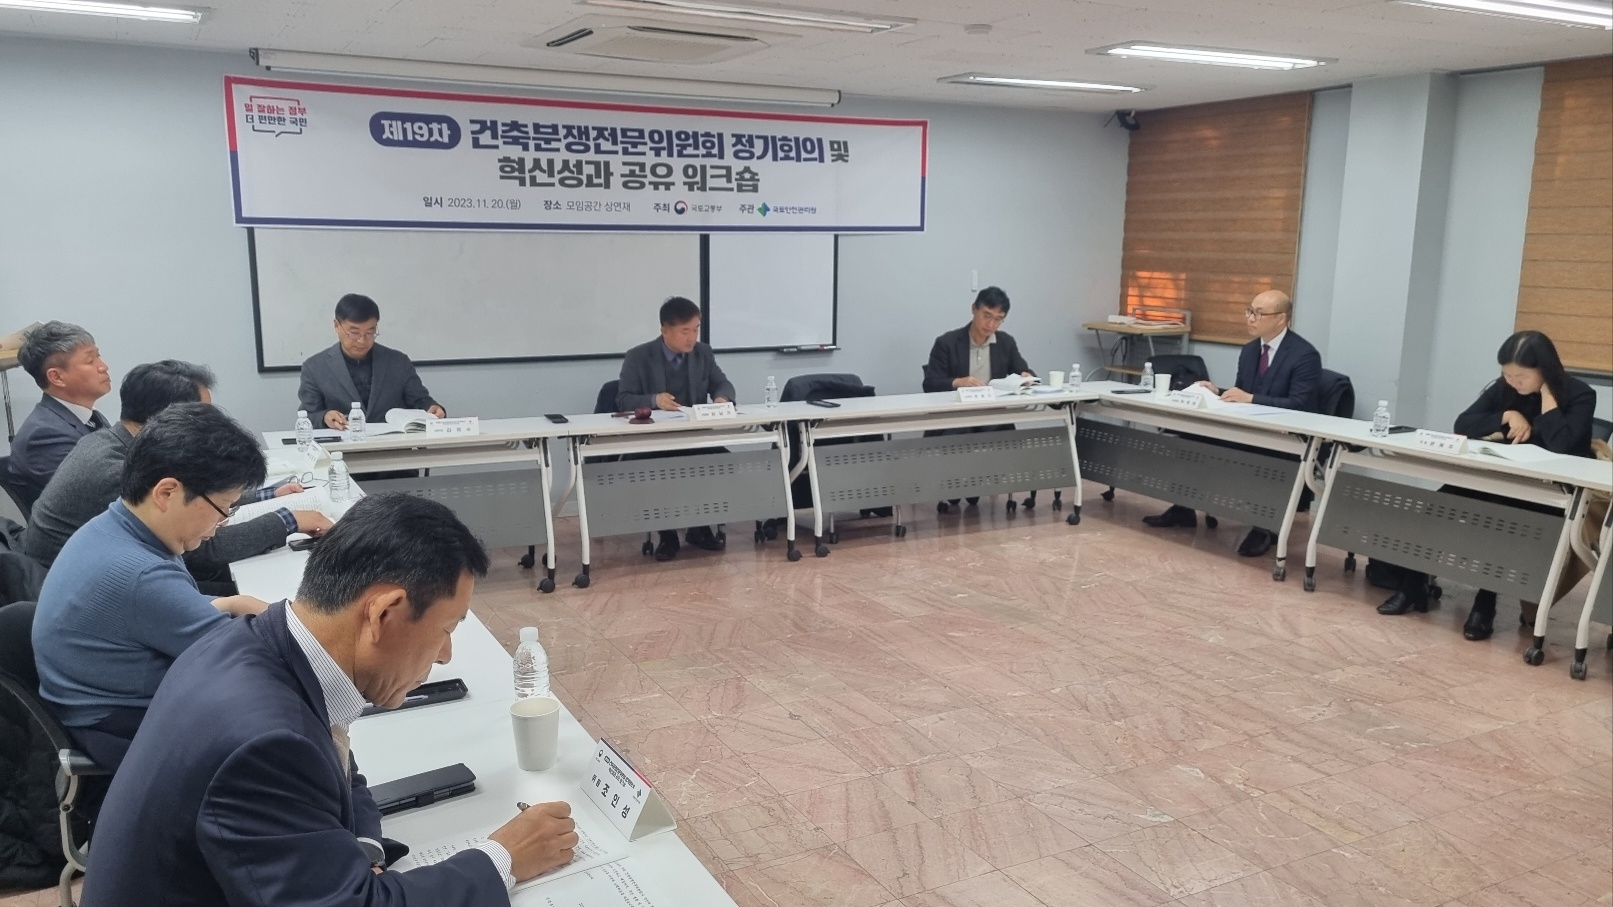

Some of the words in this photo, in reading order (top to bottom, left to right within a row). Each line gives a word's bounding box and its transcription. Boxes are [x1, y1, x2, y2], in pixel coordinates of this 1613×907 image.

[257, 103, 285, 115] 잘하는
[288, 105, 307, 116] 정부
[245, 114, 255, 124] 더
[289, 116, 308, 127] 국민
[380, 119, 451, 143] 제19차
[469, 118, 726, 161] 건축분쟁전문위원회
[731, 132, 825, 164] 정기회의
[829, 139, 850, 164] 및
[497, 156, 614, 190] 혁신성과
[620, 160, 676, 191] 공유
[682, 162, 760, 193] 워크숍
[422, 196, 443, 208] 일시
[543, 200, 562, 211] 장소
[565, 200, 602, 212] 모임공간
[604, 201, 631, 212] 상연재
[653, 202, 671, 213] 주최
[691, 204, 723, 213] 국토교통부
[739, 203, 755, 214] 주관
